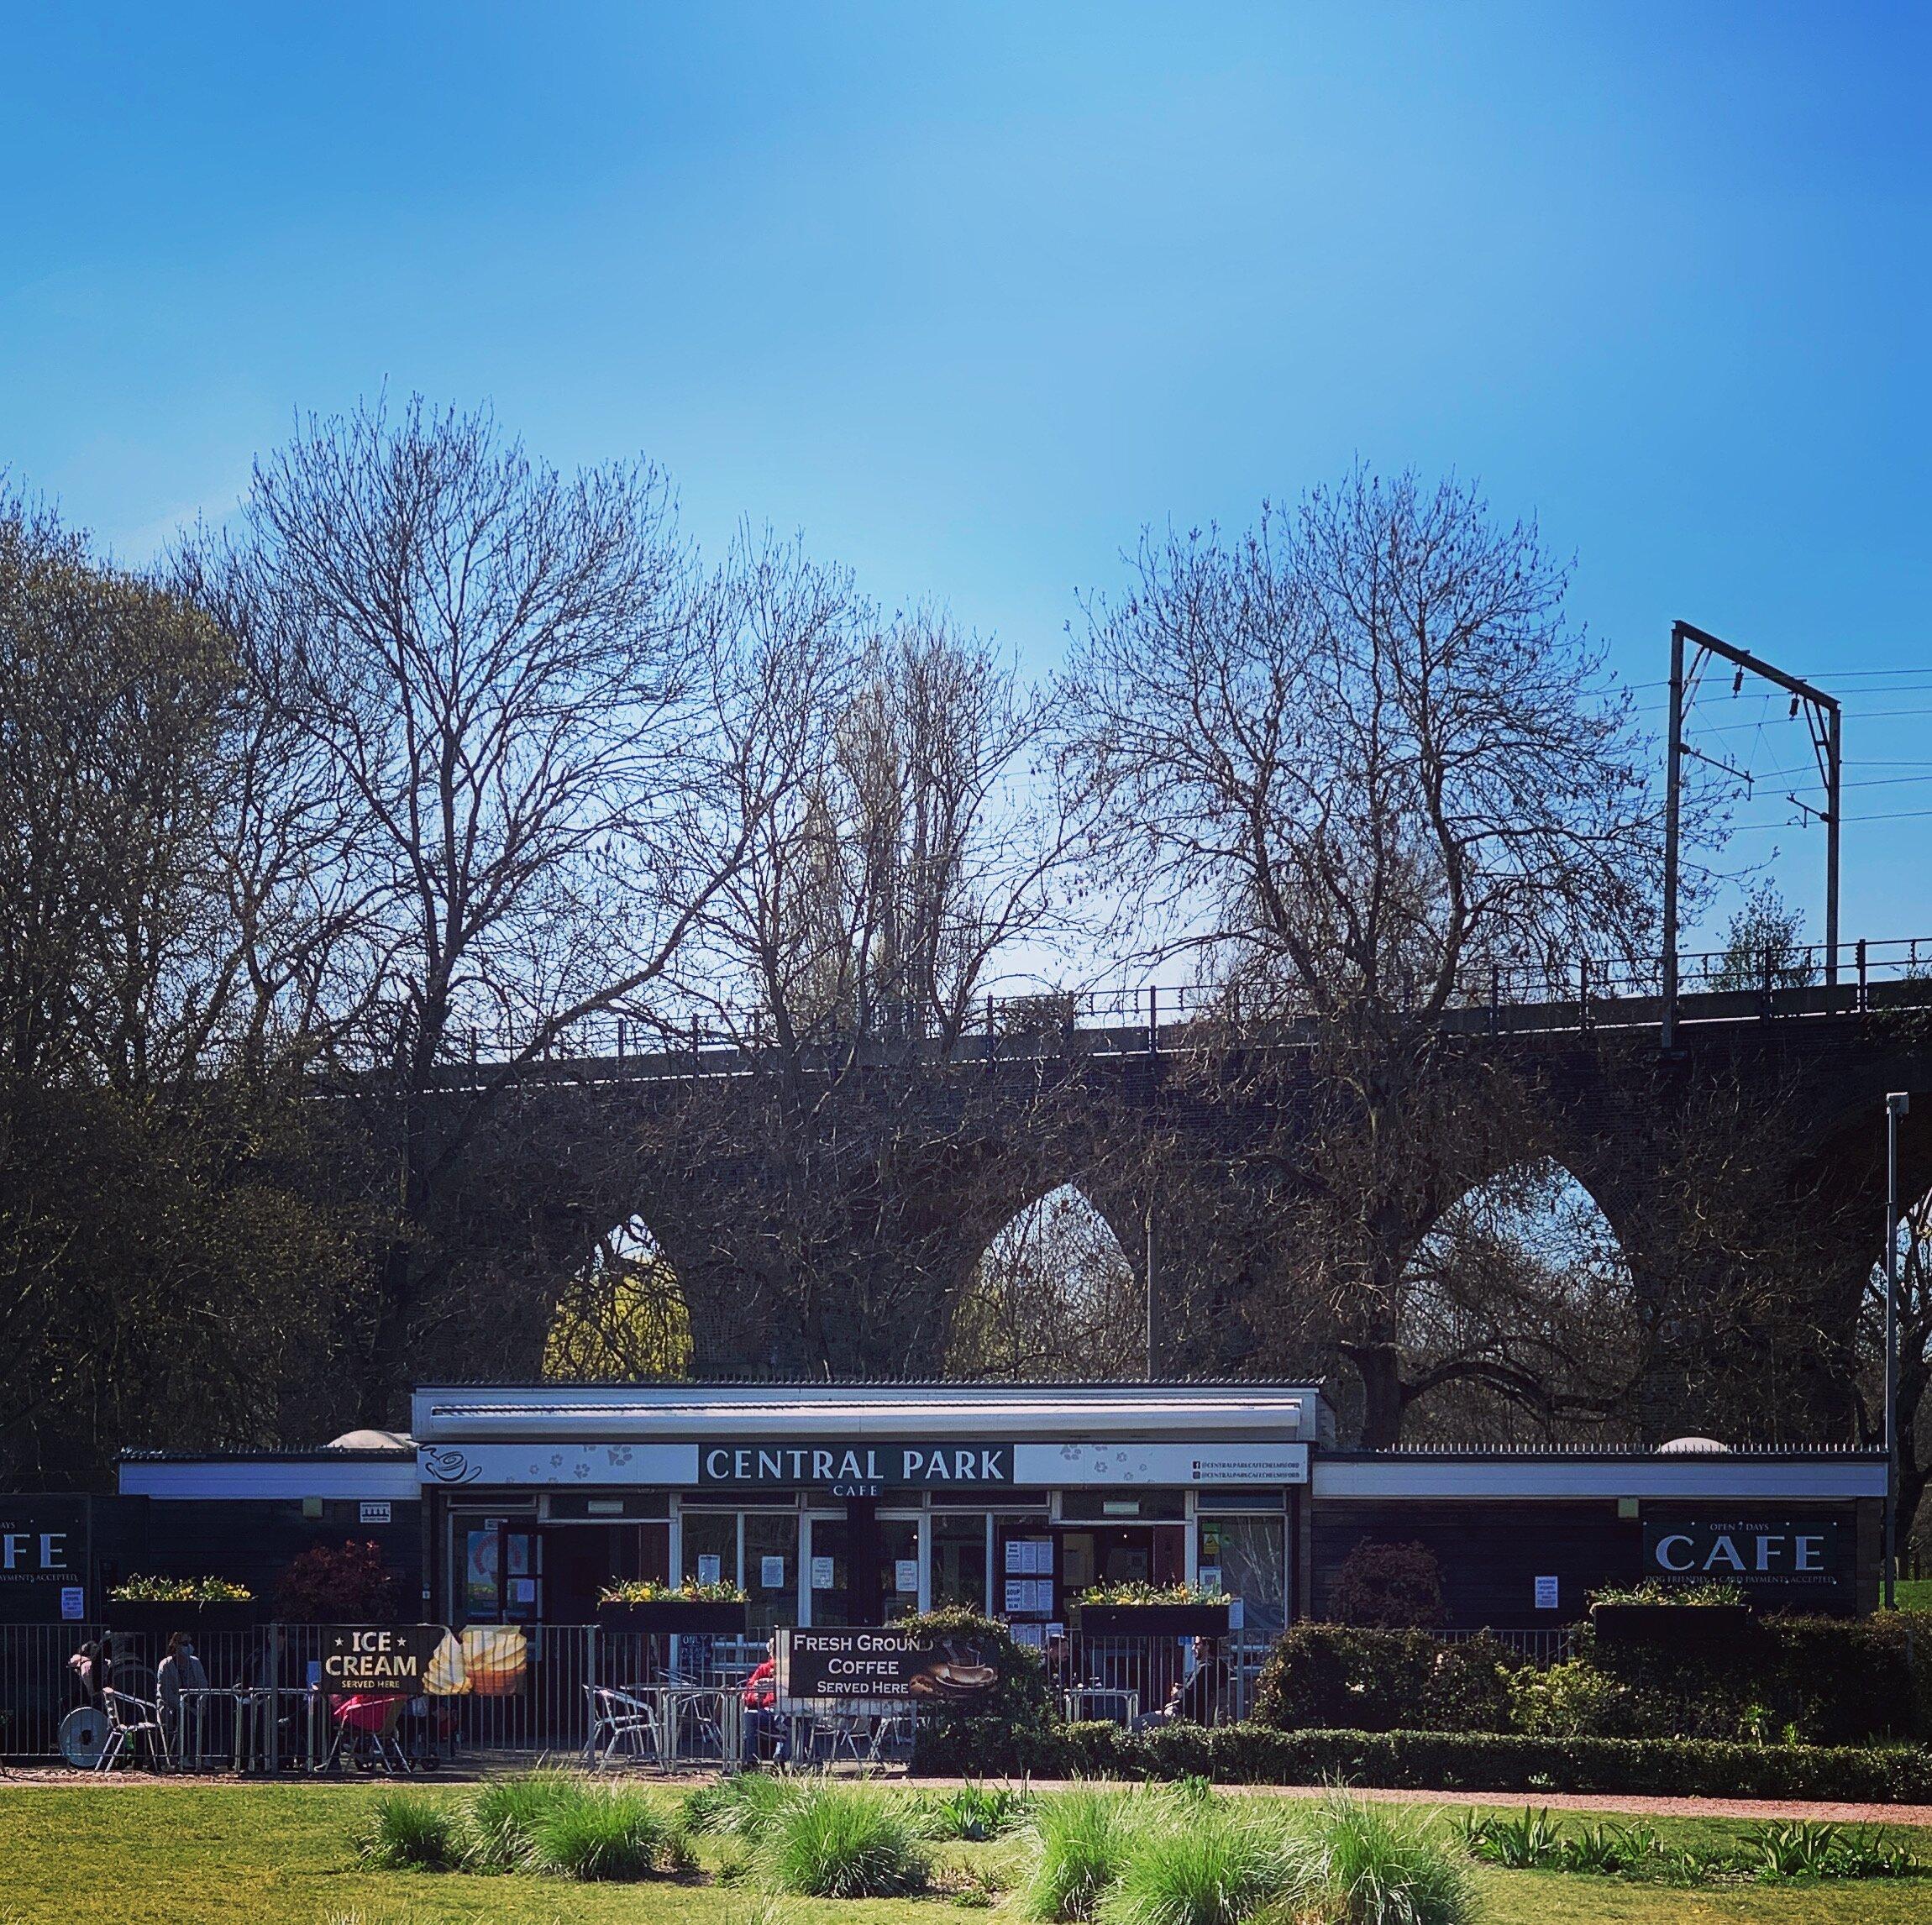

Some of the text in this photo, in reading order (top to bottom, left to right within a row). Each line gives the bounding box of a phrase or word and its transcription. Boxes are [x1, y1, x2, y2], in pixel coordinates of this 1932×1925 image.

[707, 1449, 1005, 1480] CENTRAL PARK
[832, 1485, 878, 1497] CAFE
[1709, 1523, 1735, 1531] OPEN
[1746, 1523, 1769, 1531] DAYS
[3, 1534, 67, 1569] FE
[1655, 1534, 1824, 1571] CAFE
[36, 1573, 79, 1581] ACCEPTED
[1667, 1575, 1709, 1583] FRIENDLY
[352, 1631, 391, 1652] ICE
[793, 1634, 852, 1652] FRESH
[325, 1655, 417, 1676] CREAM
[827, 1658, 899, 1675] COFFEE
[341, 1680, 400, 1689] SERVED HERE
[816, 1681, 909, 1694] SERVED HERE
